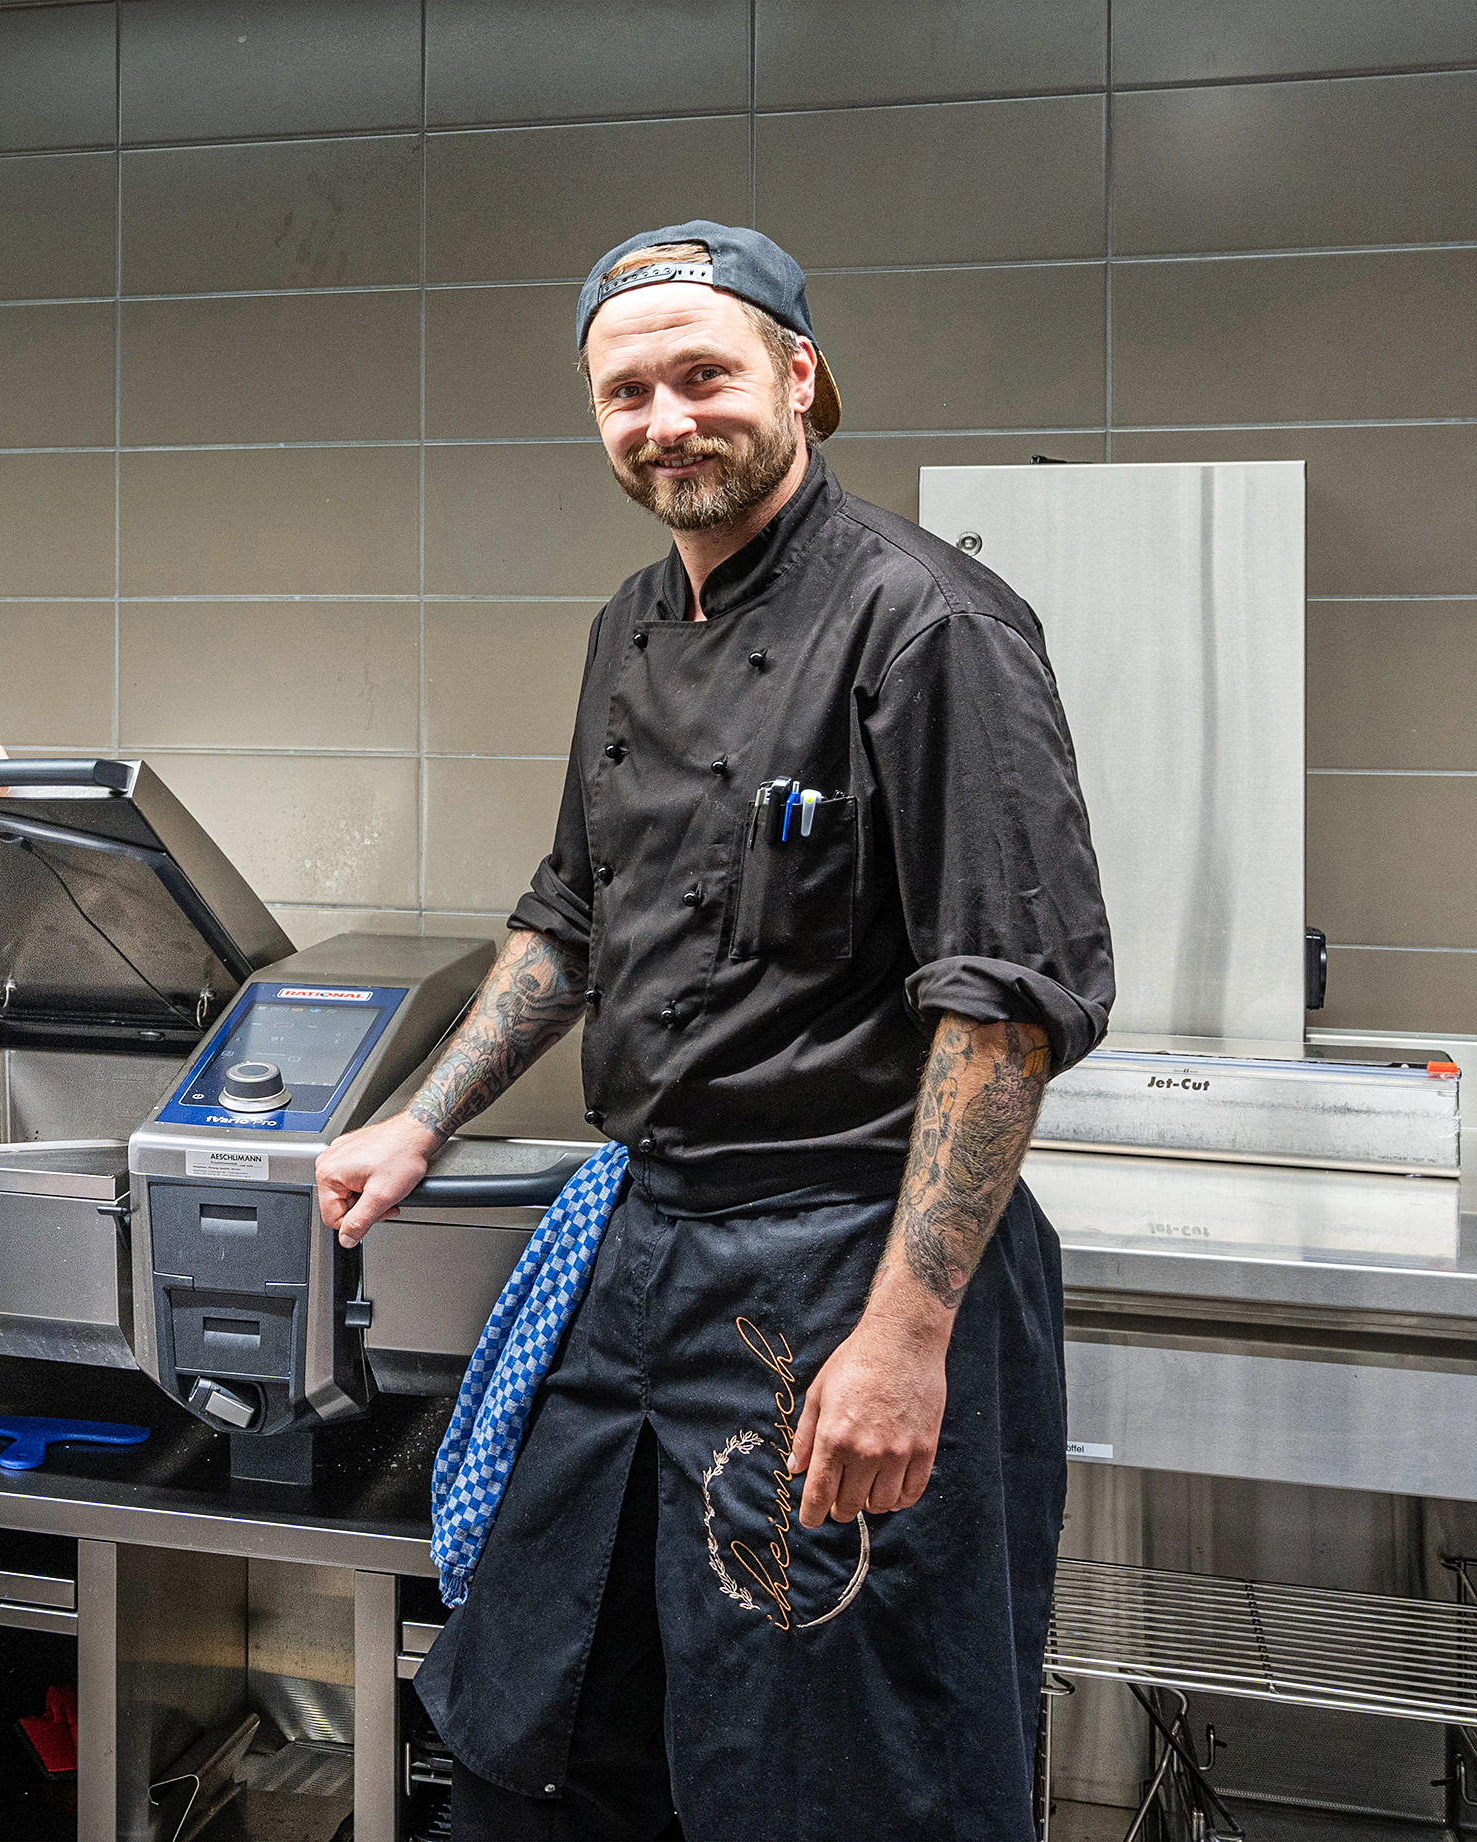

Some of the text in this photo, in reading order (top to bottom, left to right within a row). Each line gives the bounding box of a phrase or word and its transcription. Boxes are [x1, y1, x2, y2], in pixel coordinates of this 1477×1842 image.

[285, 990, 365, 999] RATIONAL
[1147, 1076, 1210, 1091] Jet-Cut
[251, 1117, 277, 1127] Pro
[210, 1153, 262, 1162] AESCHLIMANN
[1066, 1444, 1084, 1453] öffel
